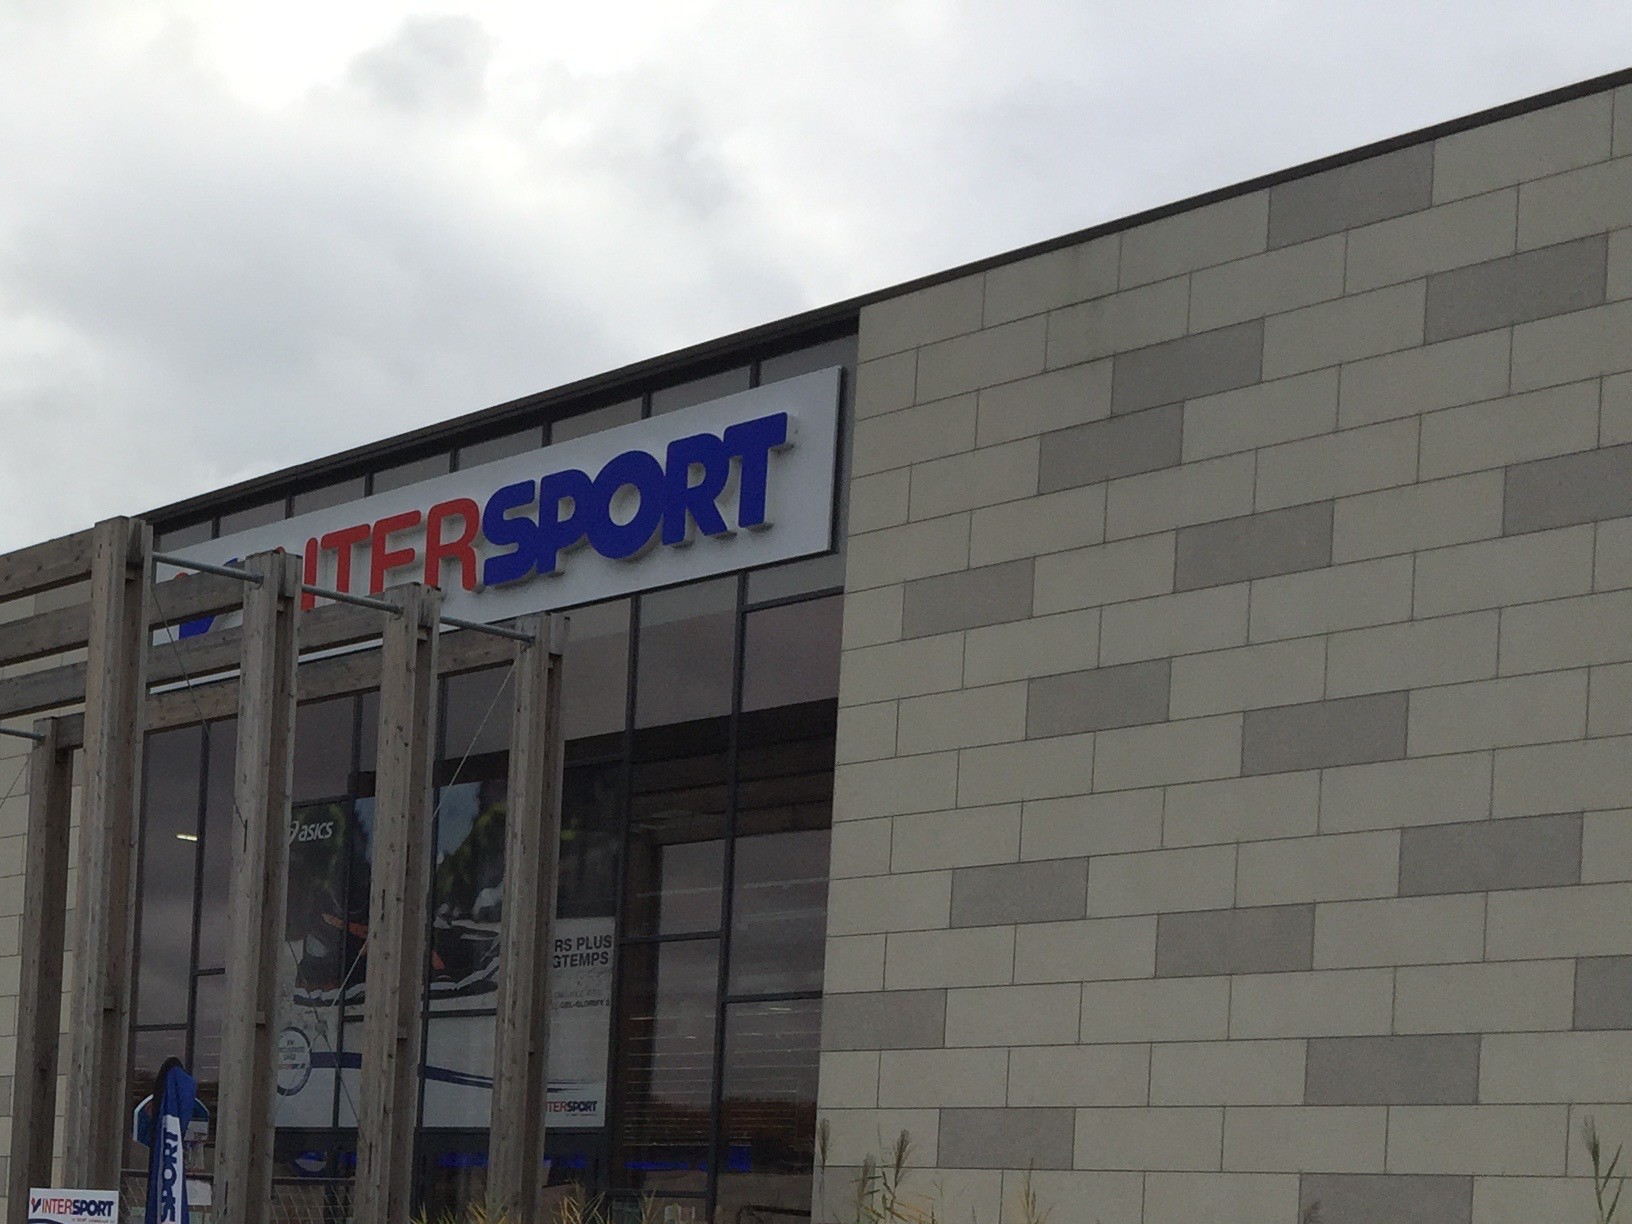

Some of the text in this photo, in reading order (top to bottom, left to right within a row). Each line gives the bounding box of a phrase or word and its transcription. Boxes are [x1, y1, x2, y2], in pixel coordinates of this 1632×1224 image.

[275, 411, 789, 611] TERSPORT
[555, 934, 613, 952] RS PLUS
[553, 951, 609, 968] GTEMPS
[544, 1100, 598, 1112] TERSPORT
[42, 1198, 115, 1217] INTERSPORT
